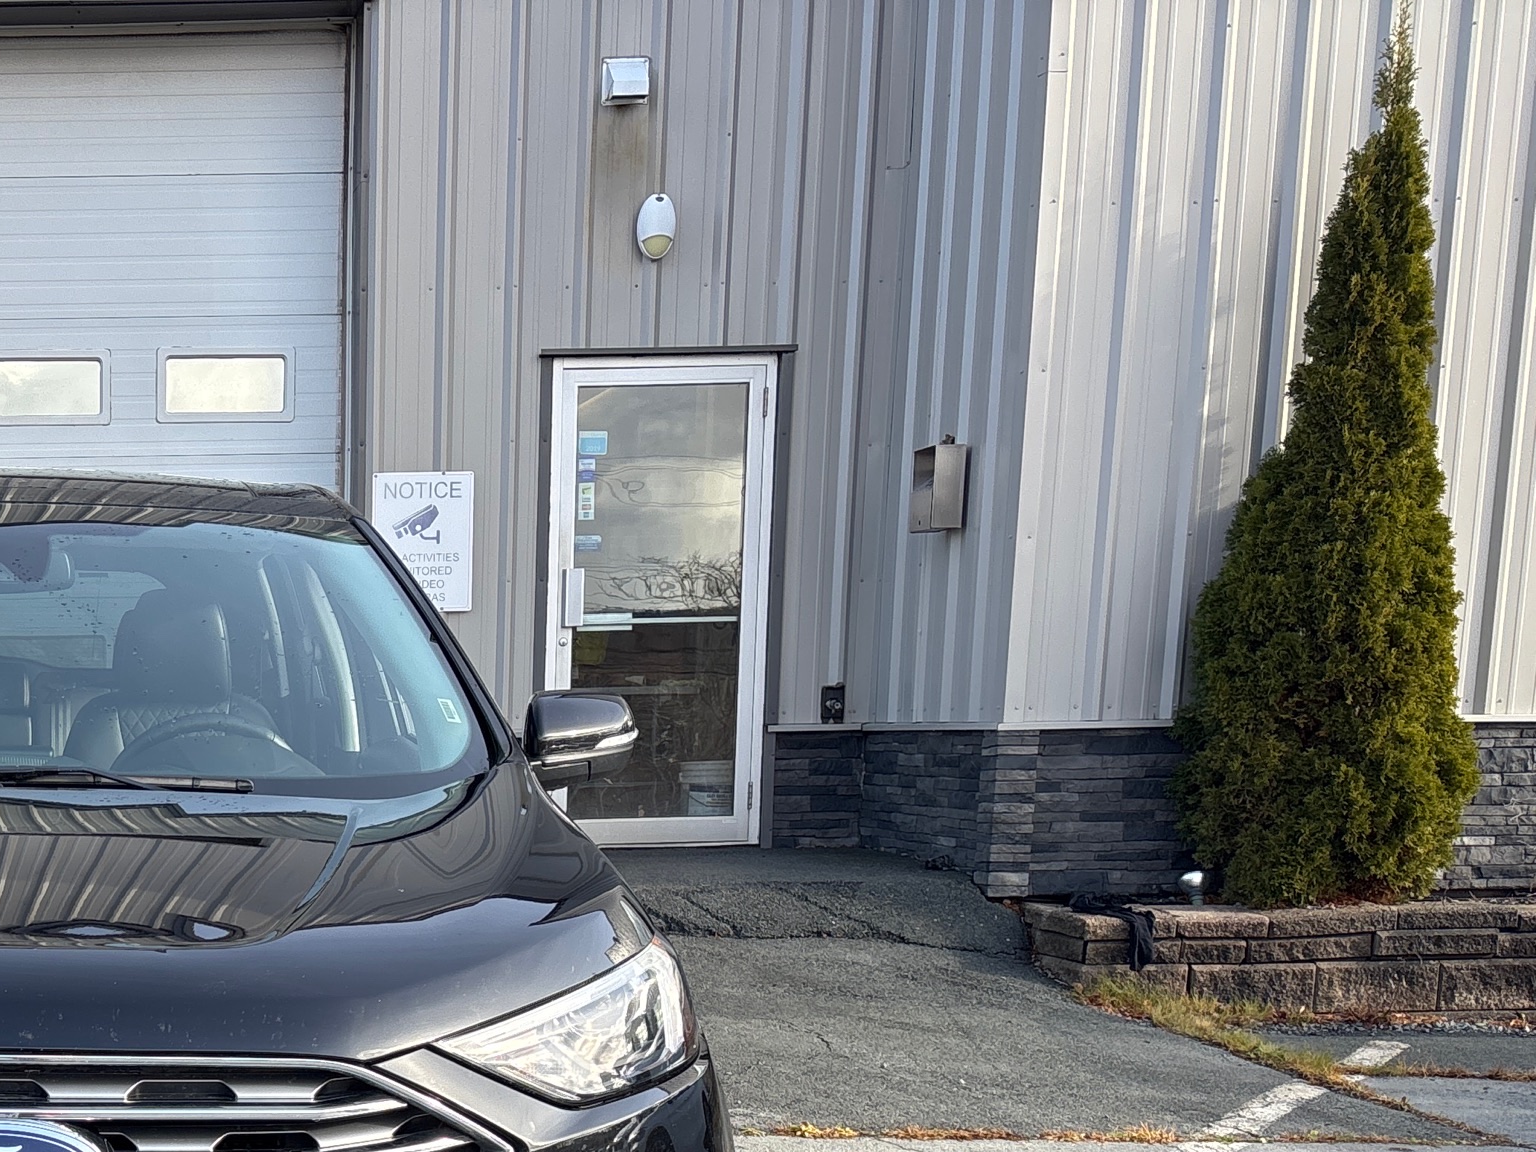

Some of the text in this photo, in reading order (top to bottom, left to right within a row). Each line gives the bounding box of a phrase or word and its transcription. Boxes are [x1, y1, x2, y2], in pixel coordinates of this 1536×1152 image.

[384, 481, 462, 499] NOTICE
[402, 552, 460, 563] ACTIVITIES
[410, 566, 453, 576] ITORED
